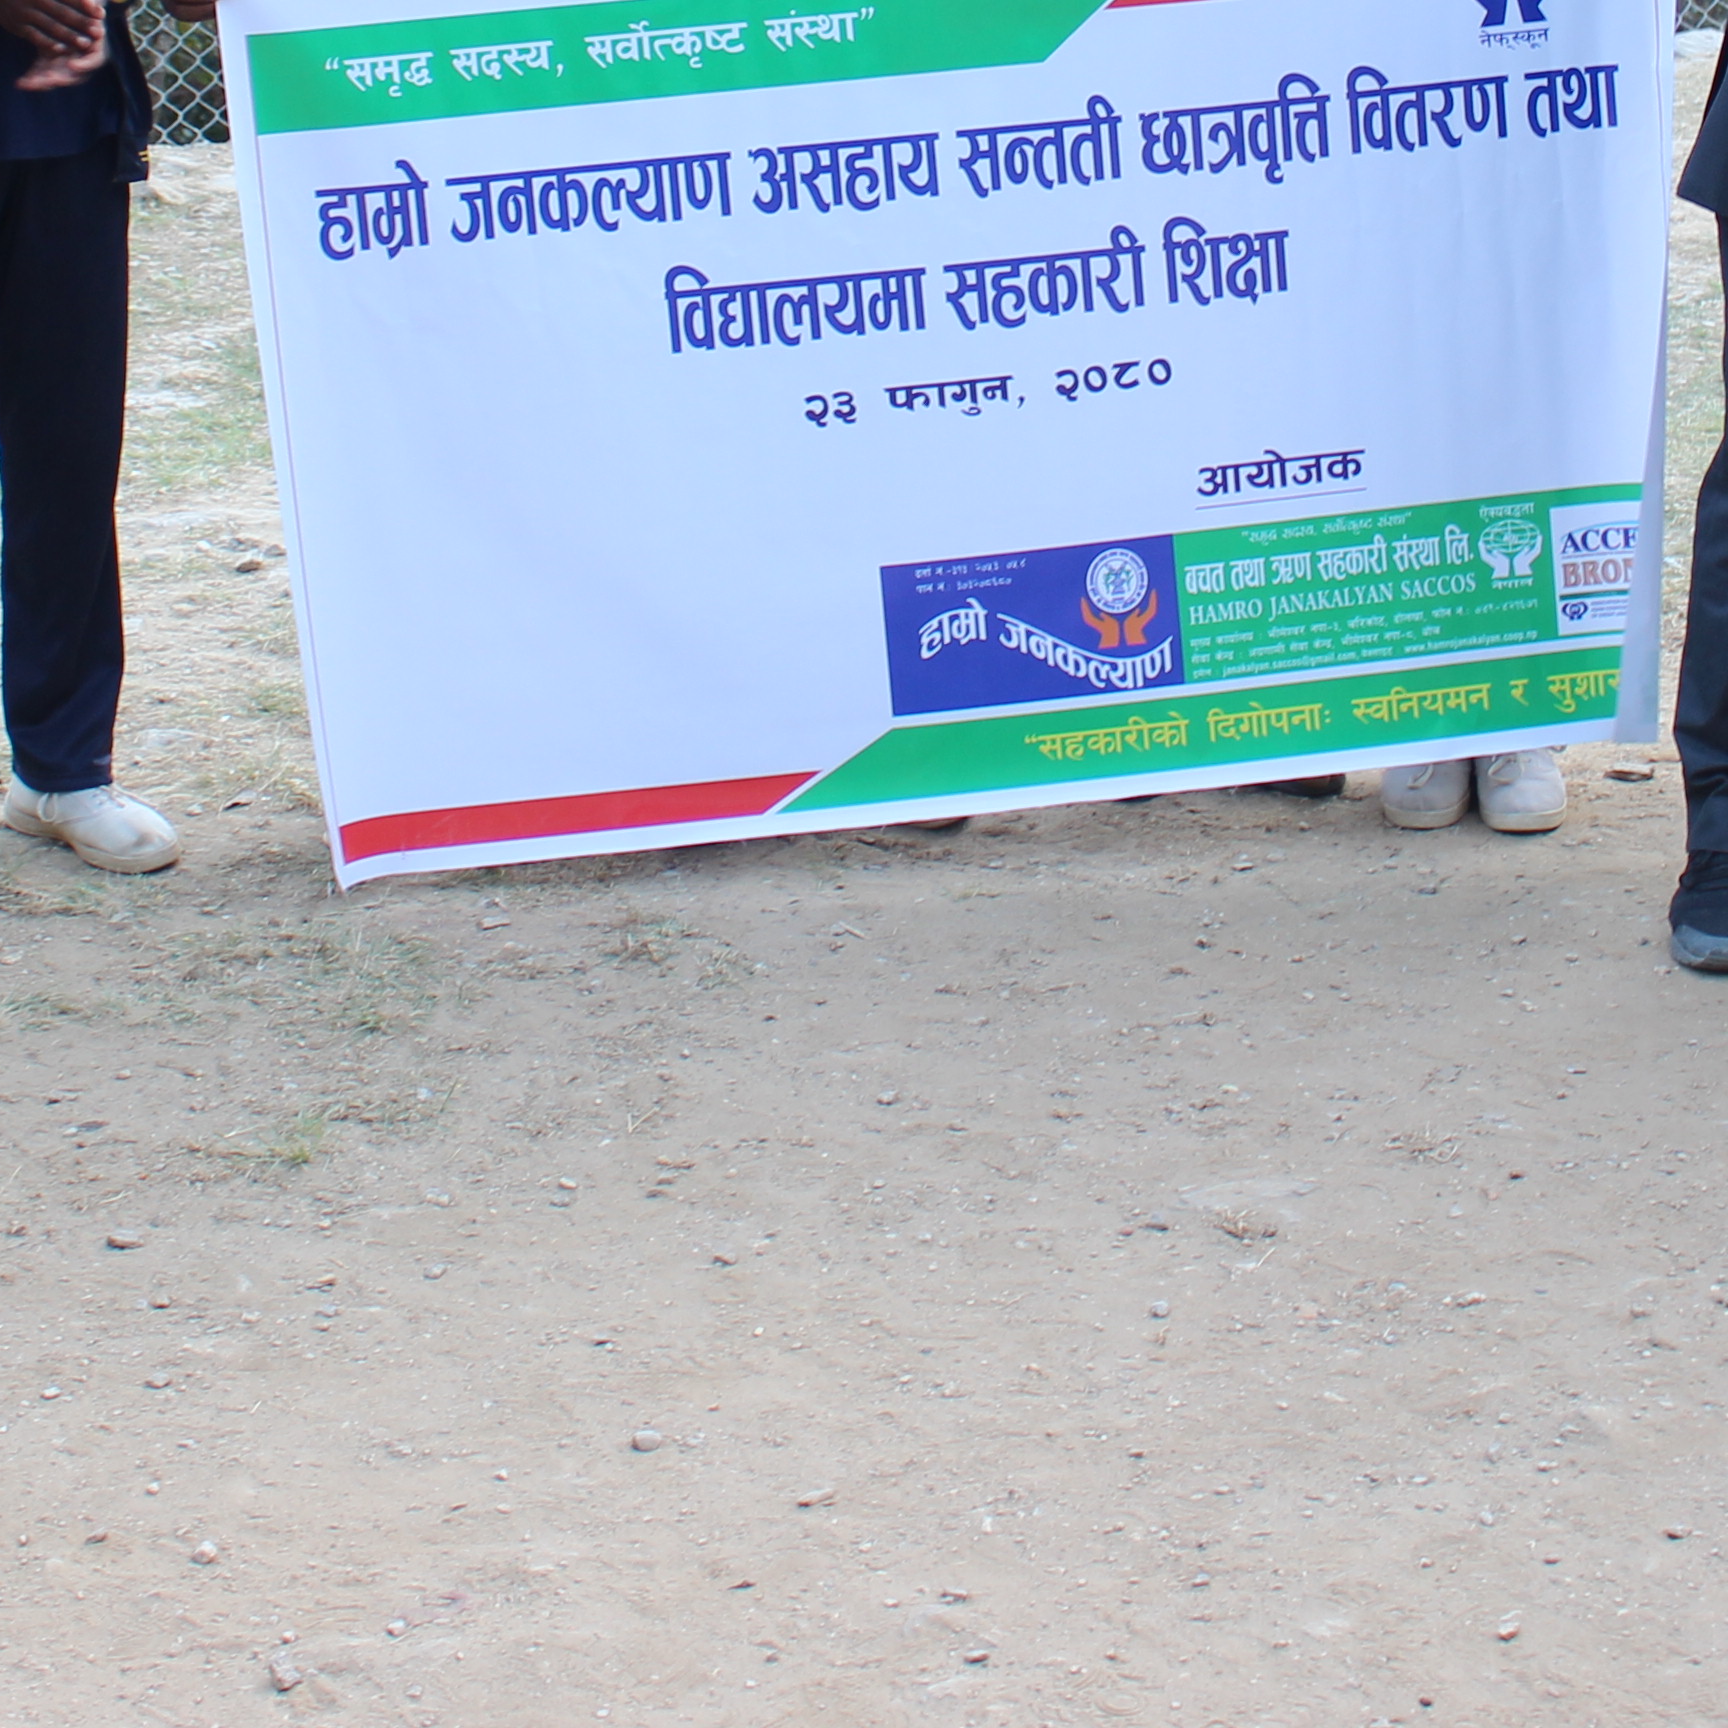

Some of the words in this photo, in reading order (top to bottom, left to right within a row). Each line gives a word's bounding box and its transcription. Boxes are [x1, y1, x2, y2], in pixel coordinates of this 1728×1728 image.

[450, 39, 564, 78] सदस्य,
[584, 20, 748, 69] सर्वोत्कृष्ट
[315, 160, 429, 261] हाम्रो
[445, 152, 731, 243] जनकल्याण
[748, 132, 940, 216] असहाय
[956, 94, 1122, 199] सन्तती
[1139, 72, 1331, 185] छात्रवृत्ति
[1347, 65, 1509, 155] वितरण
[1524, 63, 1620, 138] तथा
[665, 265, 927, 354] विद्यालयमा
[944, 224, 1146, 331] सहकारी
[1162, 216, 1290, 307] शिक्षा
[804, 391, 857, 427] २३
[884, 375, 1025, 417] फागुन,
[1055, 358, 1173, 402] २०८०
[1197, 449, 1366, 497] आयोजक
[1184, 561, 1226, 595] बचत
[1230, 557, 1266, 592] तथा
[1271, 551, 1312, 585] ऋण
[1317, 533, 1387, 582] सहकारी
[1392, 534, 1441, 571] संस्था
[1444, 524, 1475, 565] लि.
[1188, 599, 1263, 626] HAMRO
[1268, 582, 1394, 622] JANAKALYAN
[1401, 573, 1476, 601] SACCOS
[918, 597, 988, 660] हाम्रो
[996, 612, 1173, 689] जनकल्याण
[1352, 682, 1491, 724] स्वनियमन
[1510, 679, 1529, 708] र
